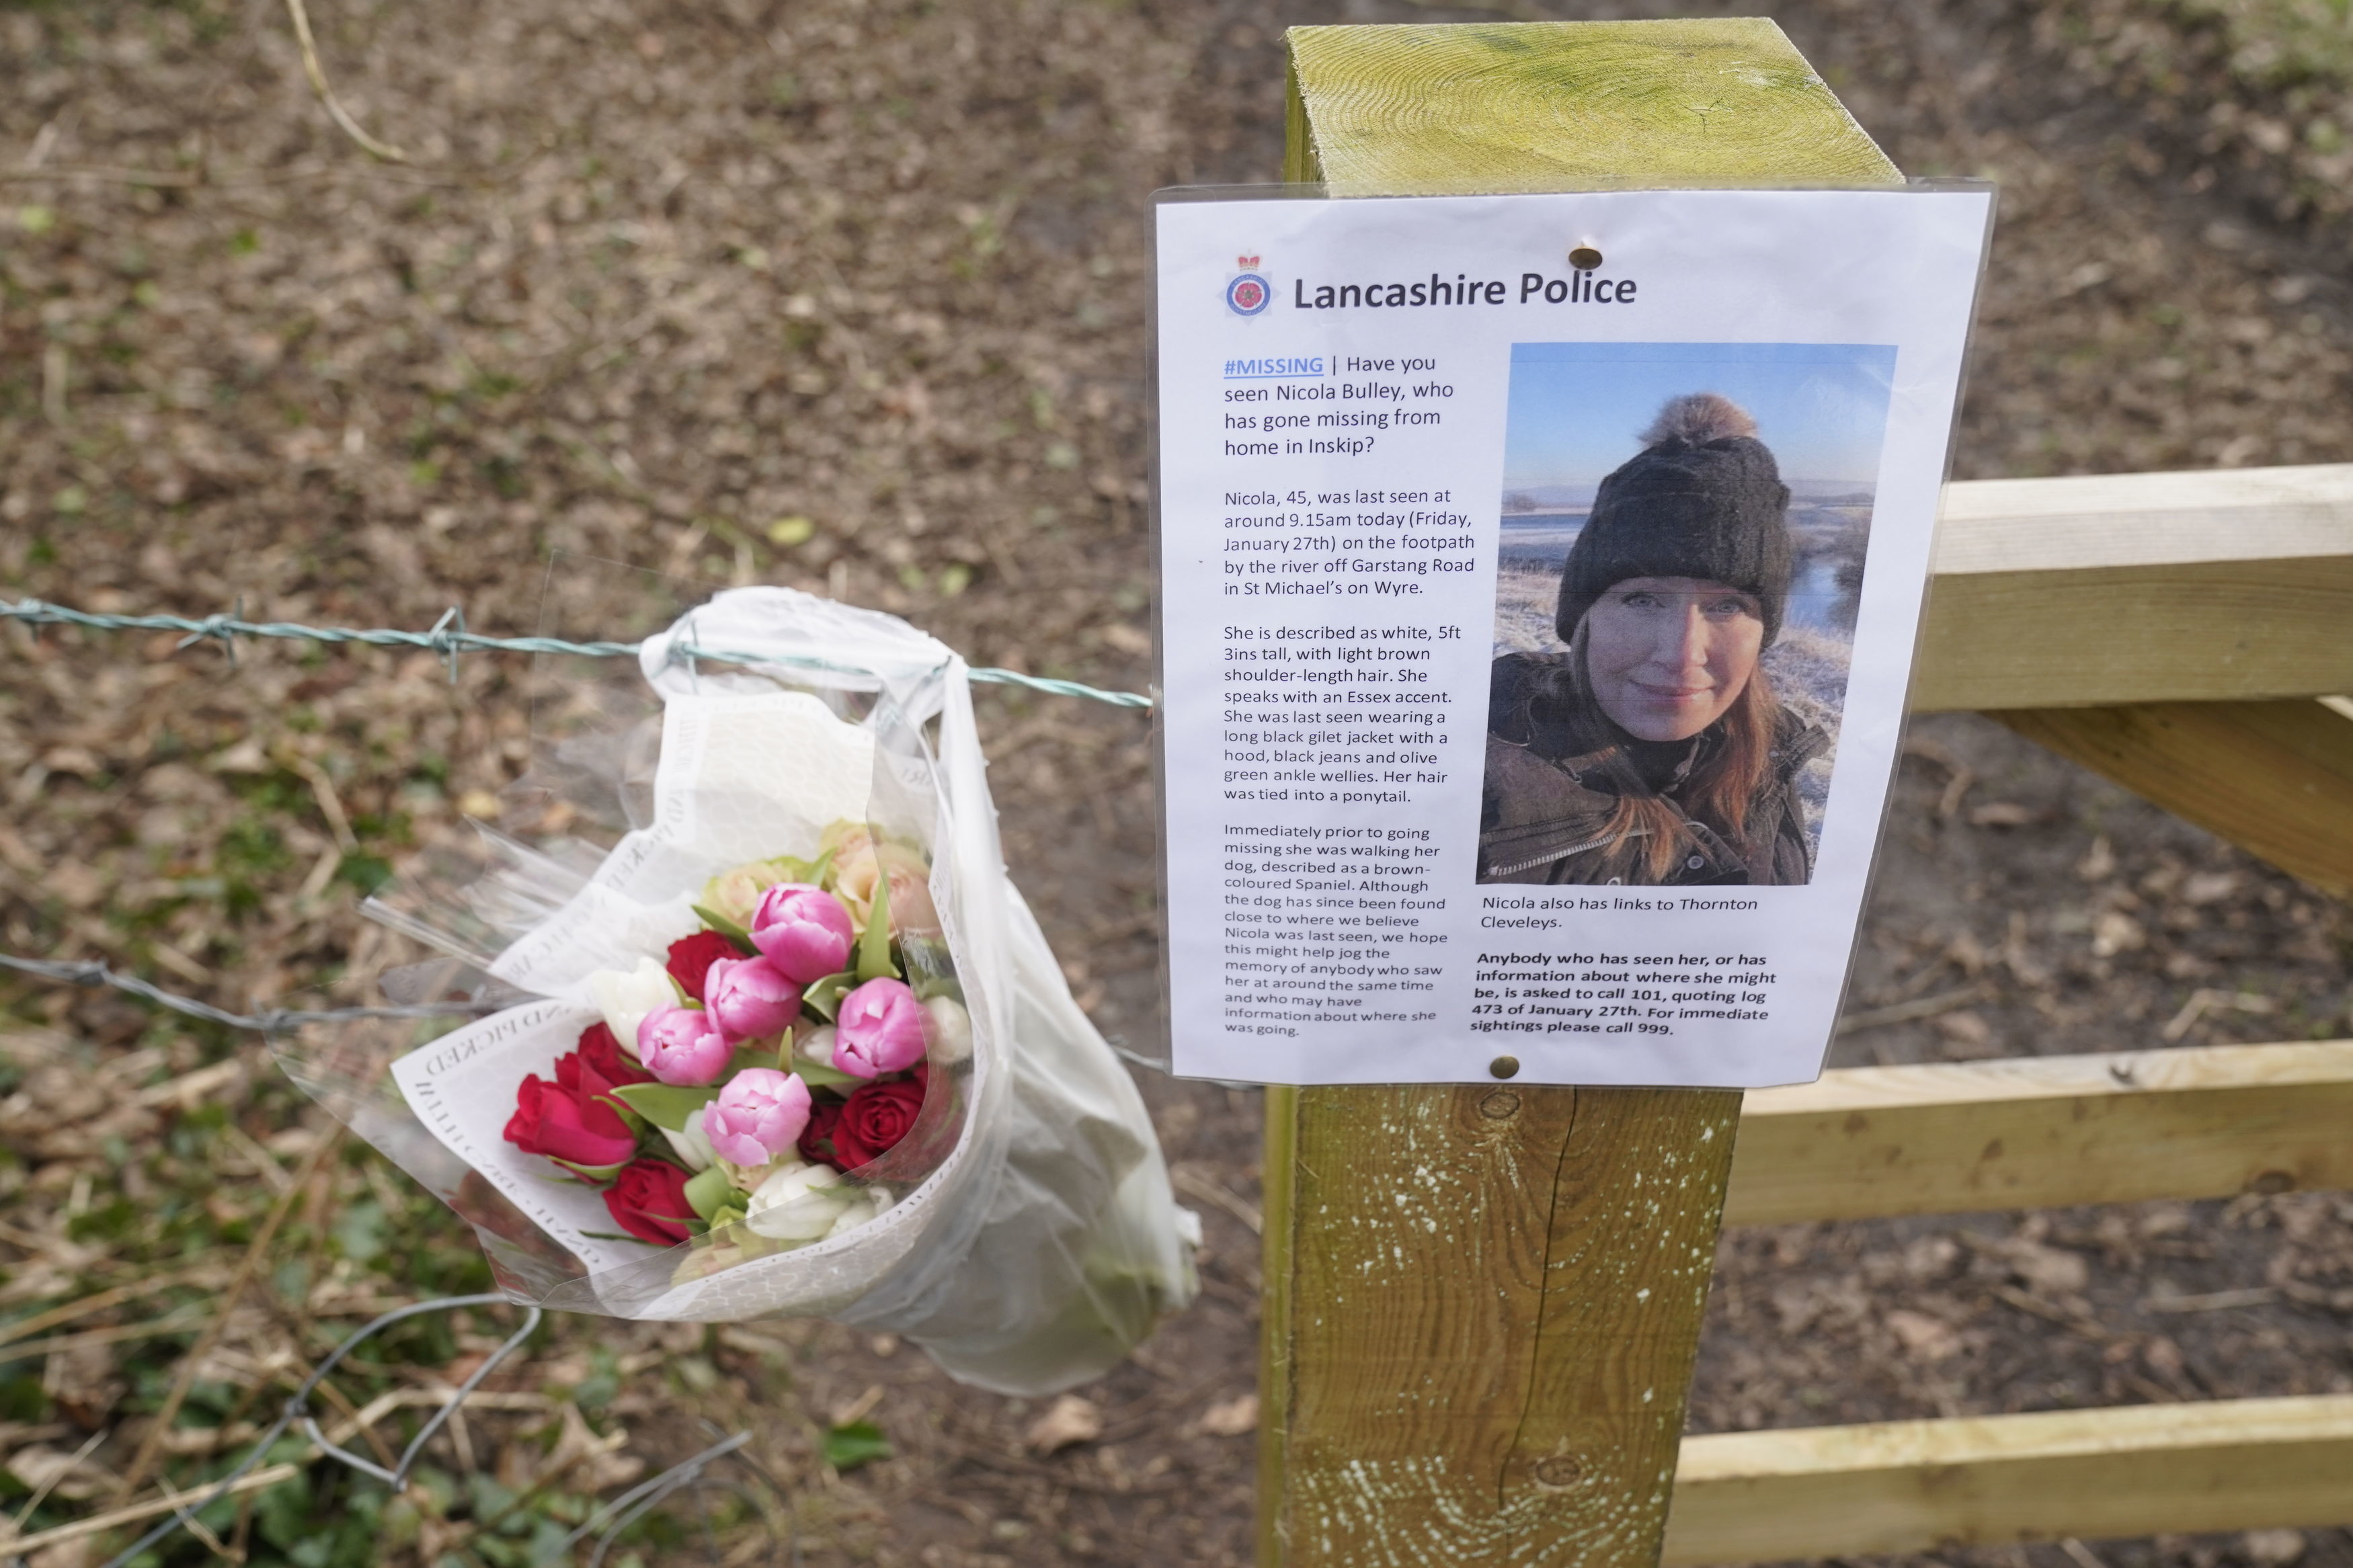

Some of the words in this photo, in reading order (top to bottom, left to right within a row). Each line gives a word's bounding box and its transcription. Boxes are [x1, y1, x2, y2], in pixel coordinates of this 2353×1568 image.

[1295, 273, 1507, 308] Lancashire
[1520, 270, 1638, 304] Police
[1224, 357, 1323, 378] #MISSING
[1347, 356, 1396, 372] Have
[1400, 358, 1435, 375] you
[1224, 388, 1269, 403] seen
[1277, 382, 1336, 401] Nicola
[1343, 382, 1406, 403] Bulley,
[1412, 380, 1453, 398] who
[1225, 413, 1257, 429] has
[1263, 415, 1310, 432] gone
[1317, 410, 1389, 429] missing
[1394, 408, 1441, 425] from
[1225, 440, 1279, 456] home
[1286, 438, 1303, 454] in
[1309, 436, 1375, 457] Inskip?
[1225, 490, 1281, 507] Nicola,
[1286, 491, 1312, 507] 45,
[1317, 493, 1351, 504] was
[1355, 489, 1386, 504] last
[1389, 491, 1428, 503] seen
[1434, 489, 1451, 503] at
[1224, 513, 1285, 528] around
[1289, 513, 1351, 528] 9.15am
[1356, 511, 1406, 529] today
[1409, 510, 1472, 529] (Friday,
[1223, 538, 1290, 554] January
[1293, 535, 1336, 553] 27th)
[1343, 538, 1363, 550] on
[1367, 534, 1396, 550] the
[1401, 534, 1474, 552] footpath
[1225, 560, 1244, 577] by
[1248, 559, 1276, 574] the
[1281, 560, 1320, 573] river
[1324, 558, 1349, 573] off
[1352, 559, 1428, 575] Garstang
[1433, 557, 1474, 572] Road
[1224, 582, 1238, 595] in
[1244, 581, 1260, 595] St
[1347, 583, 1368, 595] on
[1374, 581, 1423, 597] Wyre.
[1224, 626, 1254, 640] She
[1259, 626, 1271, 640] is
[1276, 625, 1355, 640] described
[1360, 628, 1378, 640] as
[1381, 625, 1432, 642] white,
[1438, 624, 1462, 639] 5ft
[1224, 647, 1257, 661] 3ins
[1261, 647, 1291, 663] tall,
[1295, 647, 1331, 661] with
[1338, 647, 1373, 663] light
[1378, 647, 1430, 661] brown
[1224, 668, 1353, 686] shoulder-length
[1357, 668, 1393, 682] hair.
[1398, 668, 1428, 682] She
[1224, 690, 1279, 705] speaks
[1283, 690, 1317, 704] with
[1322, 694, 1343, 704] an
[1347, 691, 1391, 704] Essex
[1395, 692, 1452, 704] accent.
[1224, 709, 1253, 723] She
[1257, 713, 1289, 723] was
[1293, 710, 1322, 723] last
[1326, 713, 1363, 723] seen
[1367, 710, 1434, 727] wearing
[1437, 713, 1445, 724] a
[1224, 729, 1259, 745] long
[1263, 730, 1304, 743] black
[1308, 731, 1343, 746] gilet
[1346, 731, 1394, 746] jacket
[1399, 731, 1433, 744] with
[1439, 734, 1447, 744] a
[1224, 749, 1270, 764] hood,
[1274, 749, 1315, 763] black
[1318, 751, 1361, 766] jeans
[1365, 751, 1396, 764] and
[1400, 751, 1437, 764] olive
[1224, 770, 1268, 782] green
[1273, 769, 1316, 782] ankle
[1320, 770, 1378, 783] wellies.
[1384, 770, 1412, 783] Her
[1417, 770, 1448, 784] hair
[1224, 790, 1255, 800] was
[1258, 788, 1288, 800] tied
[1294, 789, 1325, 801] into
[1329, 792, 1339, 802] a
[1343, 790, 1411, 805] ponytail.
[1225, 824, 1322, 840] Immediately
[1325, 826, 1364, 839] prior
[1366, 827, 1383, 838] to
[1387, 827, 1430, 841] going
[1224, 842, 1282, 857] missing
[1285, 843, 1312, 856] she
[1316, 846, 1347, 856] was
[1350, 844, 1410, 860] walking
[1414, 845, 1441, 857] her
[1224, 859, 1257, 874] dog,
[1261, 860, 1336, 874] described
[1341, 864, 1357, 874] as
[1361, 865, 1369, 874] a
[1374, 863, 1431, 875] brown-
[1224, 877, 1291, 889] coloured
[1295, 878, 1355, 892] Spaniel.
[1359, 880, 1429, 895] Although
[1482, 896, 1535, 909] Nicola
[1540, 897, 1574, 910] also
[1579, 897, 1607, 910] has
[1613, 897, 1652, 911] links
[1657, 899, 1674, 911] to
[1679, 898, 1758, 910] Thornton
[1480, 915, 1562, 931] Cleveleys.
[1476, 952, 1552, 966] Anybody
[1556, 952, 1594, 964] who
[1599, 952, 1628, 964] has
[1633, 956, 1674, 965] seen
[1678, 953, 1710, 967] her,
[1715, 956, 1734, 965] or
[1738, 954, 1767, 966] has
[1476, 969, 1575, 982] information
[1581, 970, 1630, 983] about
[1636, 971, 1691, 983] where
[1693, 972, 1723, 984] she
[1728, 971, 1777, 987] might
[1474, 987, 1499, 999] be,
[1505, 987, 1517, 998] is
[1522, 987, 1571, 999] asked
[1575, 989, 1593, 999] to
[1597, 987, 1625, 999] call
[1631, 989, 1667, 1003] 101,
[1671, 990, 1737, 1005] quoting
[1741, 990, 1767, 1005] log
[1471, 1004, 1503, 1015] 473
[1507, 1003, 1525, 1015] of
[1527, 1004, 1593, 1019] January
[1598, 1005, 1642, 1017] 27th.
[1647, 1007, 1675, 1019] For
[1679, 1007, 1769, 1020] immediate
[1224, 1024, 1253, 1033] was
[1257, 1026, 1300, 1038] going.
[1470, 1020, 1543, 1033] sightings
[1547, 1021, 1601, 1034] please
[1605, 1022, 1634, 1034] call
[1638, 1022, 1673, 1036] 999.
